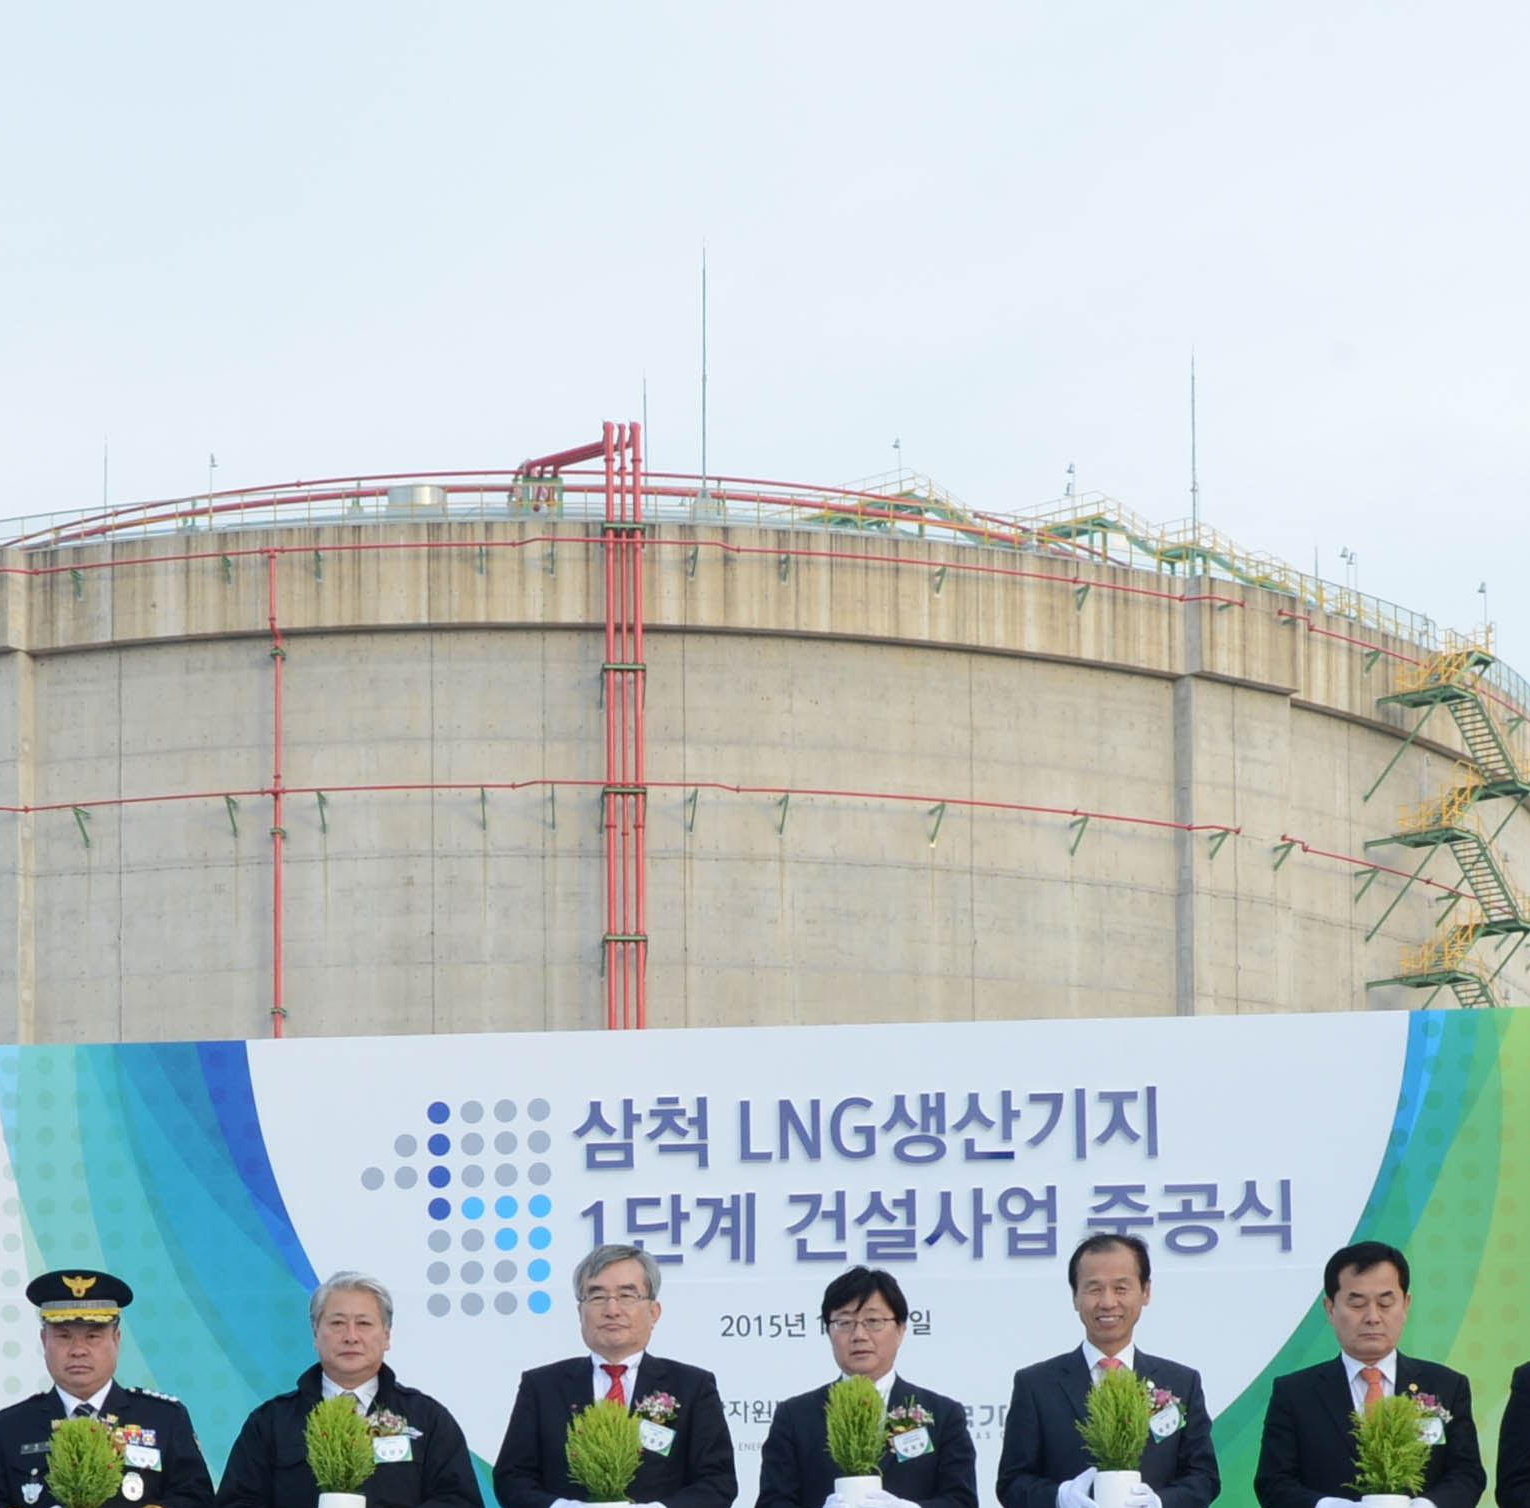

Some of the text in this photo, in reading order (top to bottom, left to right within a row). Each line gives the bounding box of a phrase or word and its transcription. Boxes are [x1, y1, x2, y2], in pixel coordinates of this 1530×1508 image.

[573, 1086, 1158, 1169] 삼척 LNG생산기지
[581, 1192, 756, 1264] 1단계
[787, 1186, 1057, 1262] 건설사업
[721, 1312, 806, 1338] 2015년
